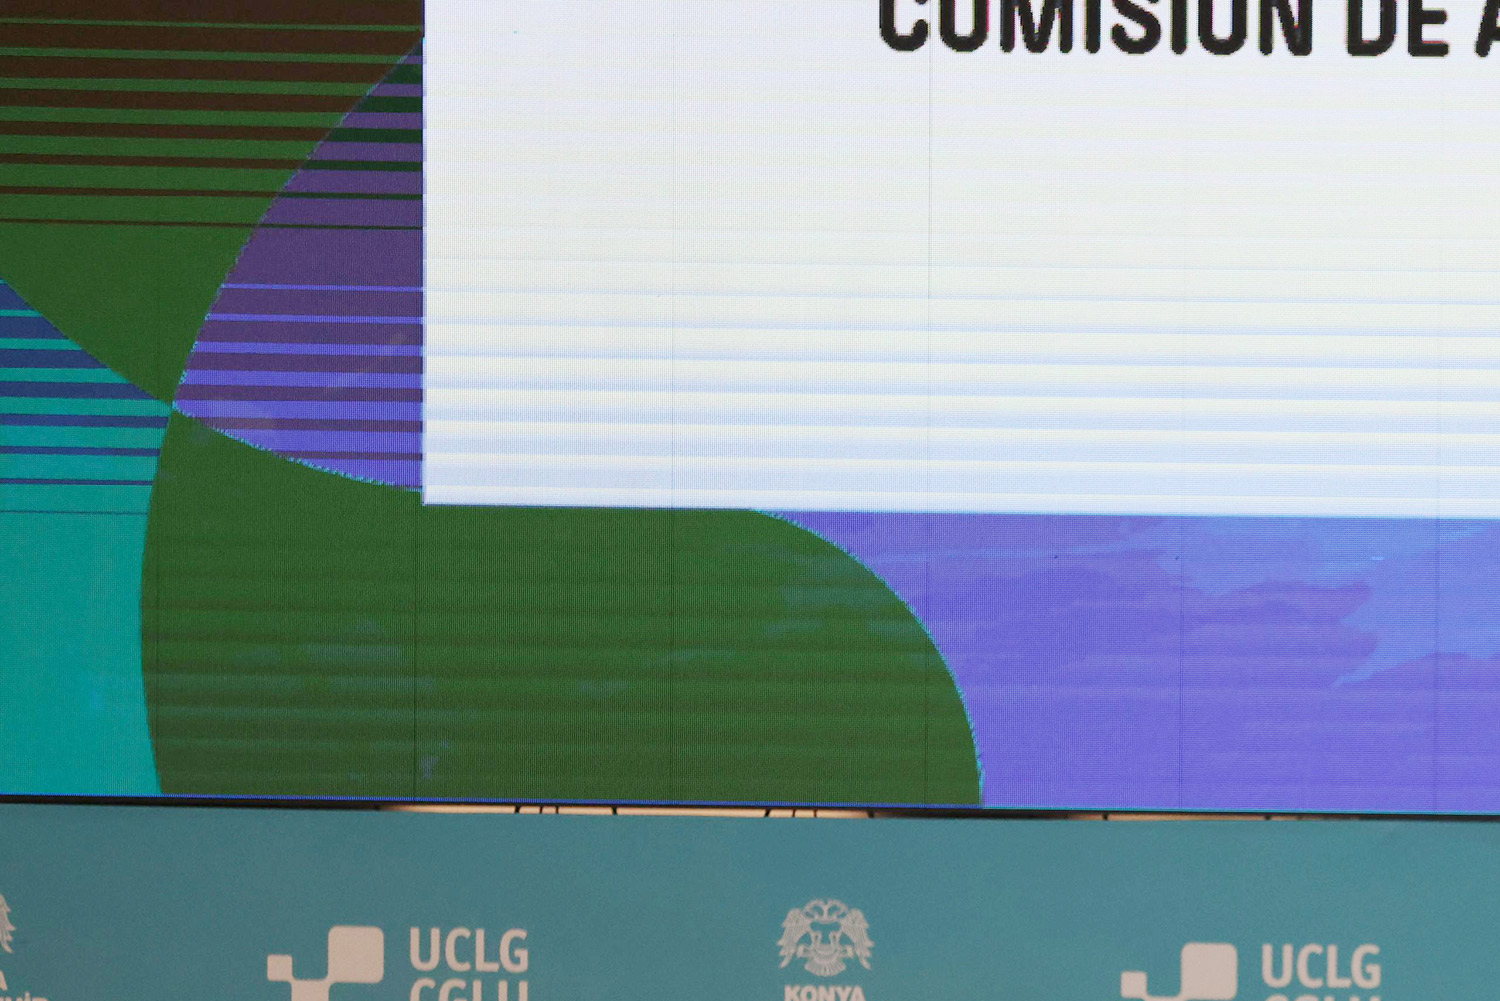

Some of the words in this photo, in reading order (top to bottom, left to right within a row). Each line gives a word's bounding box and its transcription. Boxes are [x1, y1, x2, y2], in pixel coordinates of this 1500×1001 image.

[1346, 0, 1449, 57] DE
[409, 926, 530, 973] UCLG
[1261, 943, 1382, 989] UCLG
